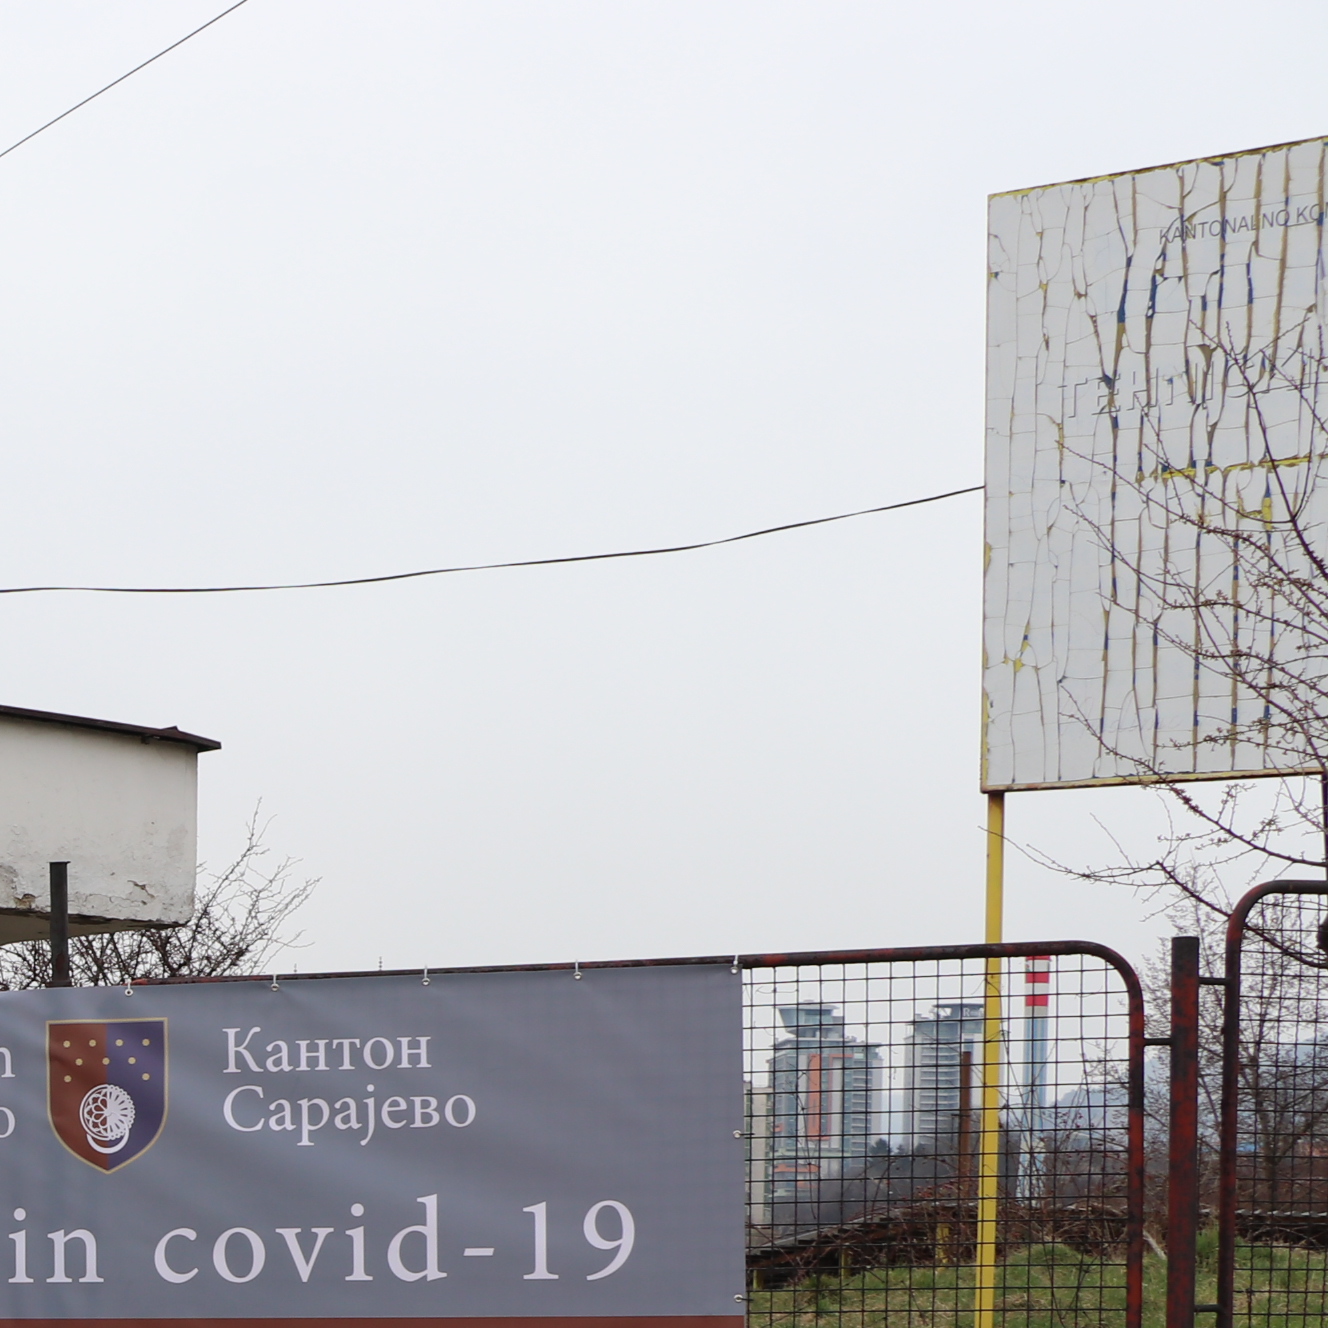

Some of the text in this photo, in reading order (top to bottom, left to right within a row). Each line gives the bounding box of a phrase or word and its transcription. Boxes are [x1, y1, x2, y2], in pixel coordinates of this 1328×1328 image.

[1158, 208, 1290, 246] KANTONALNO
[222, 1026, 432, 1073] Кантон
[223, 1084, 476, 1146] Сарајево
[154, 1193, 635, 1284] covid-19
